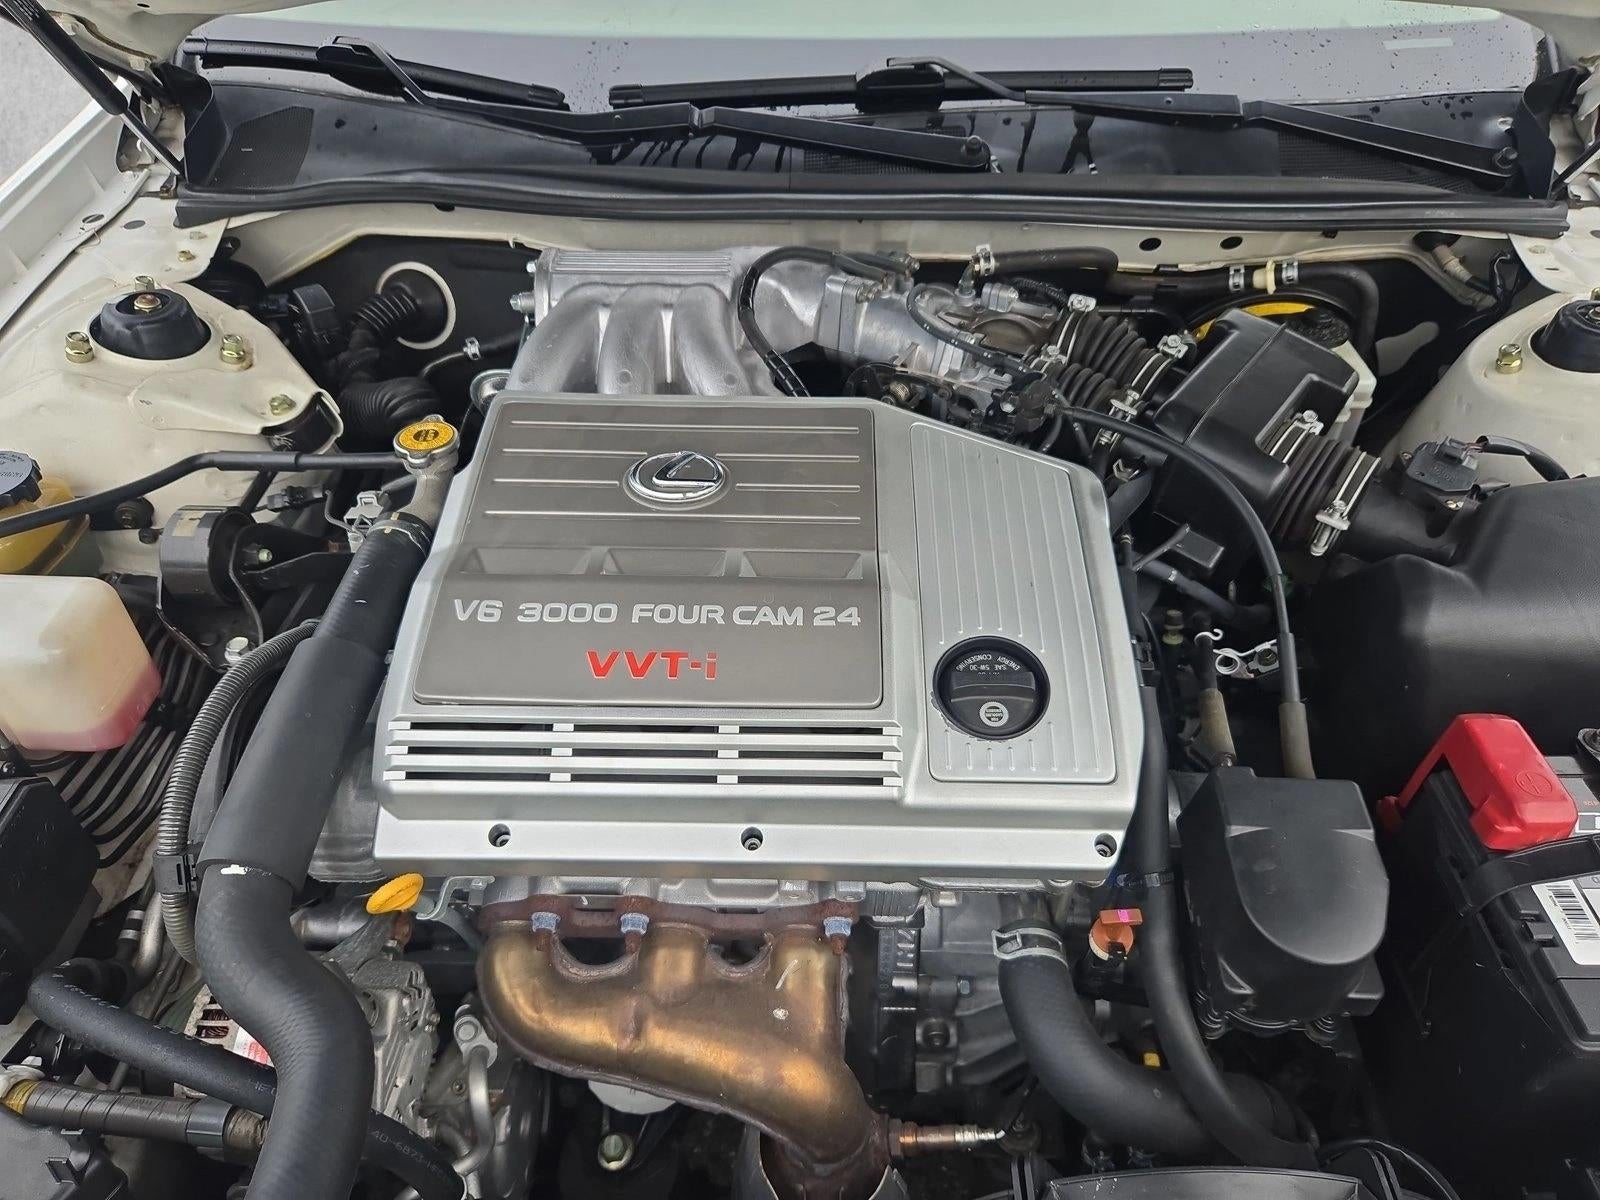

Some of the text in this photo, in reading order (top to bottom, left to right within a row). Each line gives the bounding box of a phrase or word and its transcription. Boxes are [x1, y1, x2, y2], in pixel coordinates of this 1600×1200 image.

[453, 598, 862, 627] V6 3000 FOUR CAM 24
[586, 649, 718, 680] VVT-i
[956, 653, 1021, 672] ENERGY CONSERVING
